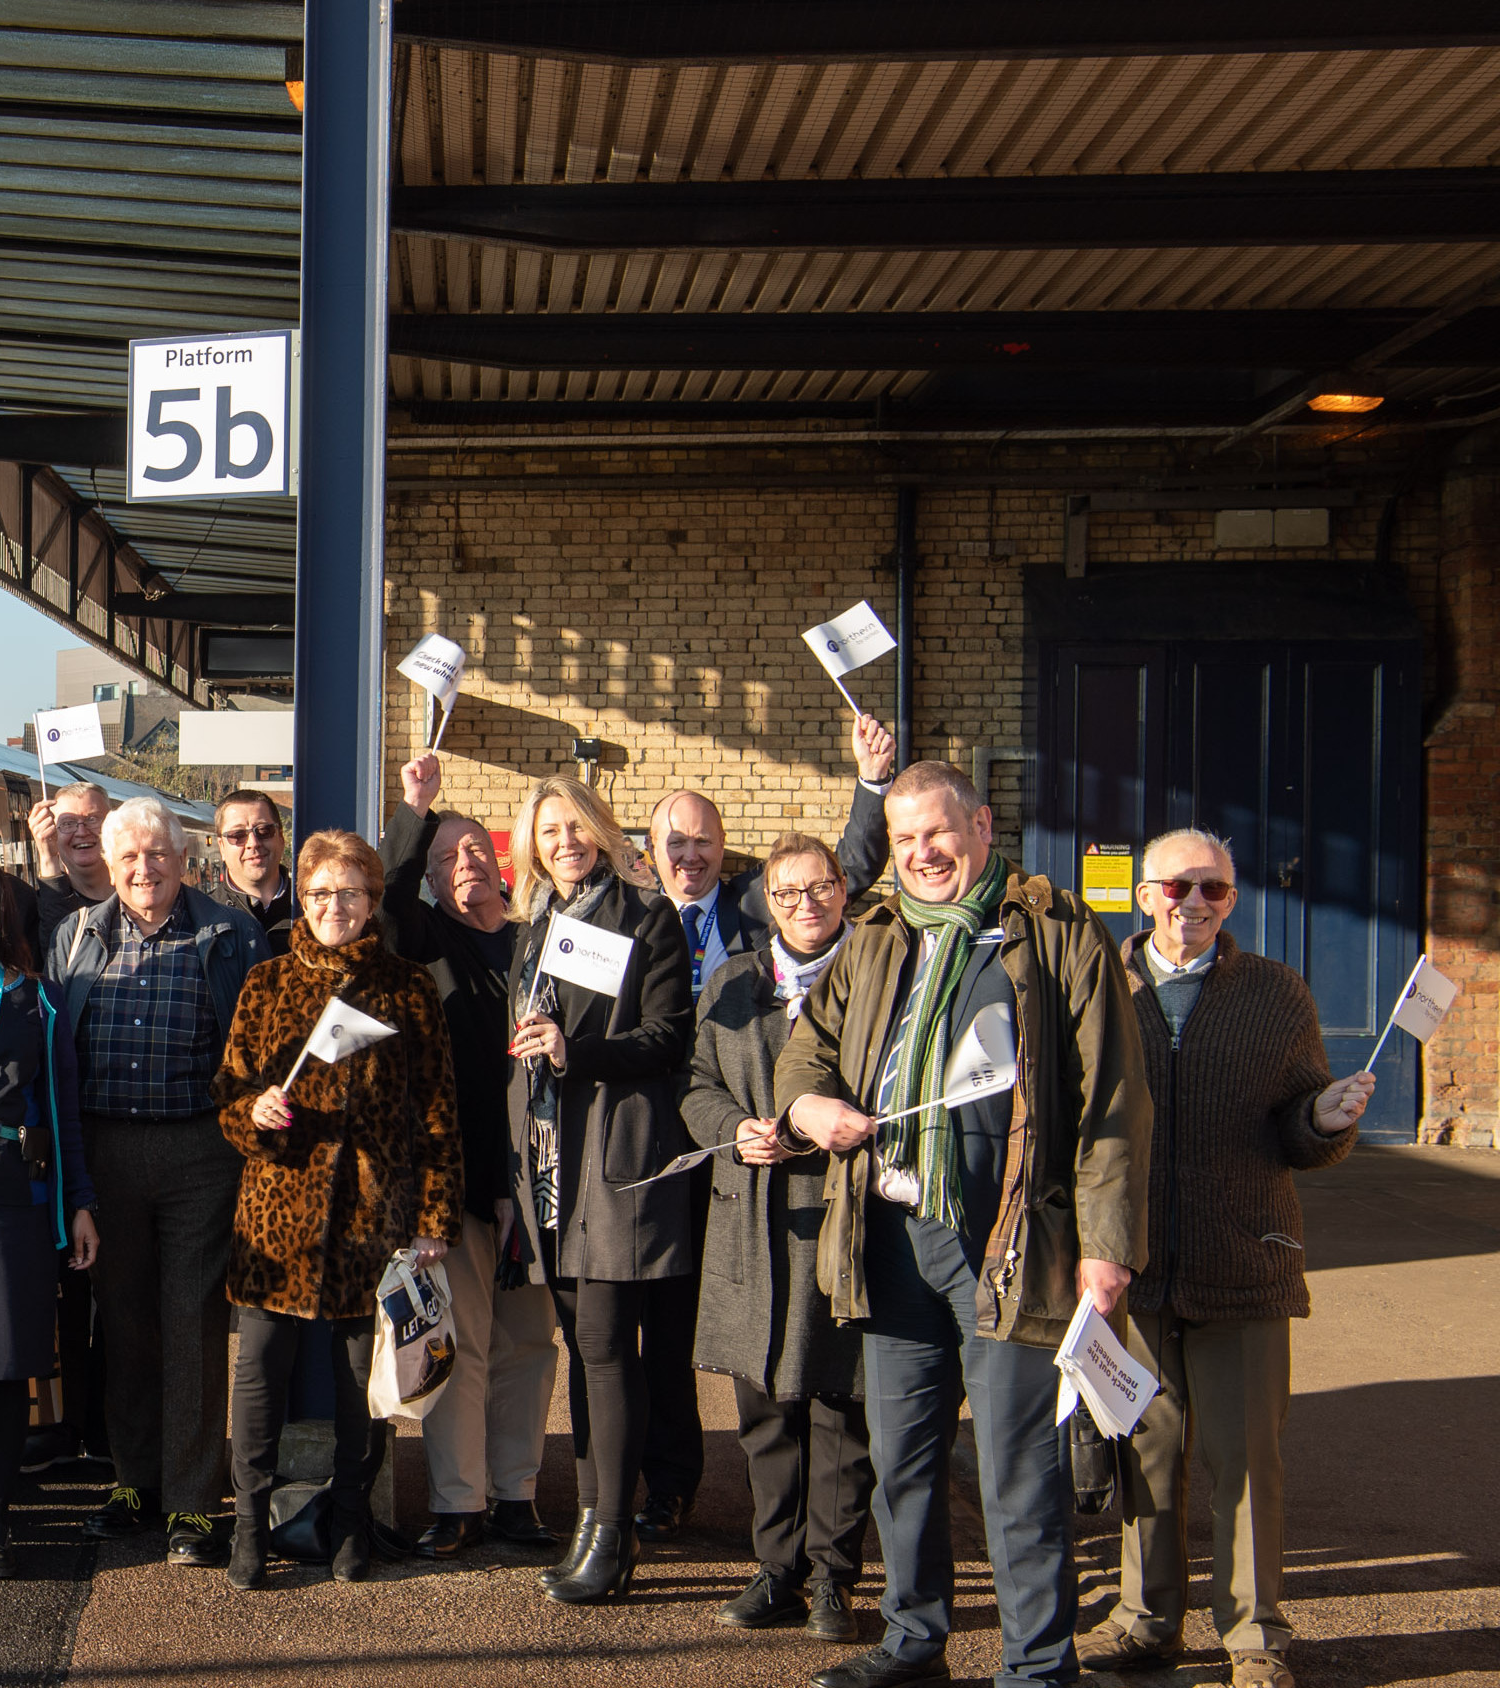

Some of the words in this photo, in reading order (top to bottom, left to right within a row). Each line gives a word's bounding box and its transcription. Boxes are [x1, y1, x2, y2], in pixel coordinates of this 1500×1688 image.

[166, 346, 252, 367] Platform
[143, 385, 273, 482] 5b
[1086, 1346, 1100, 1365] the
[1092, 1339, 1118, 1372] wheels
[1098, 1364, 1111, 1377] out
[1118, 1369, 1139, 1389] new
[1110, 1374, 1137, 1403] Check
